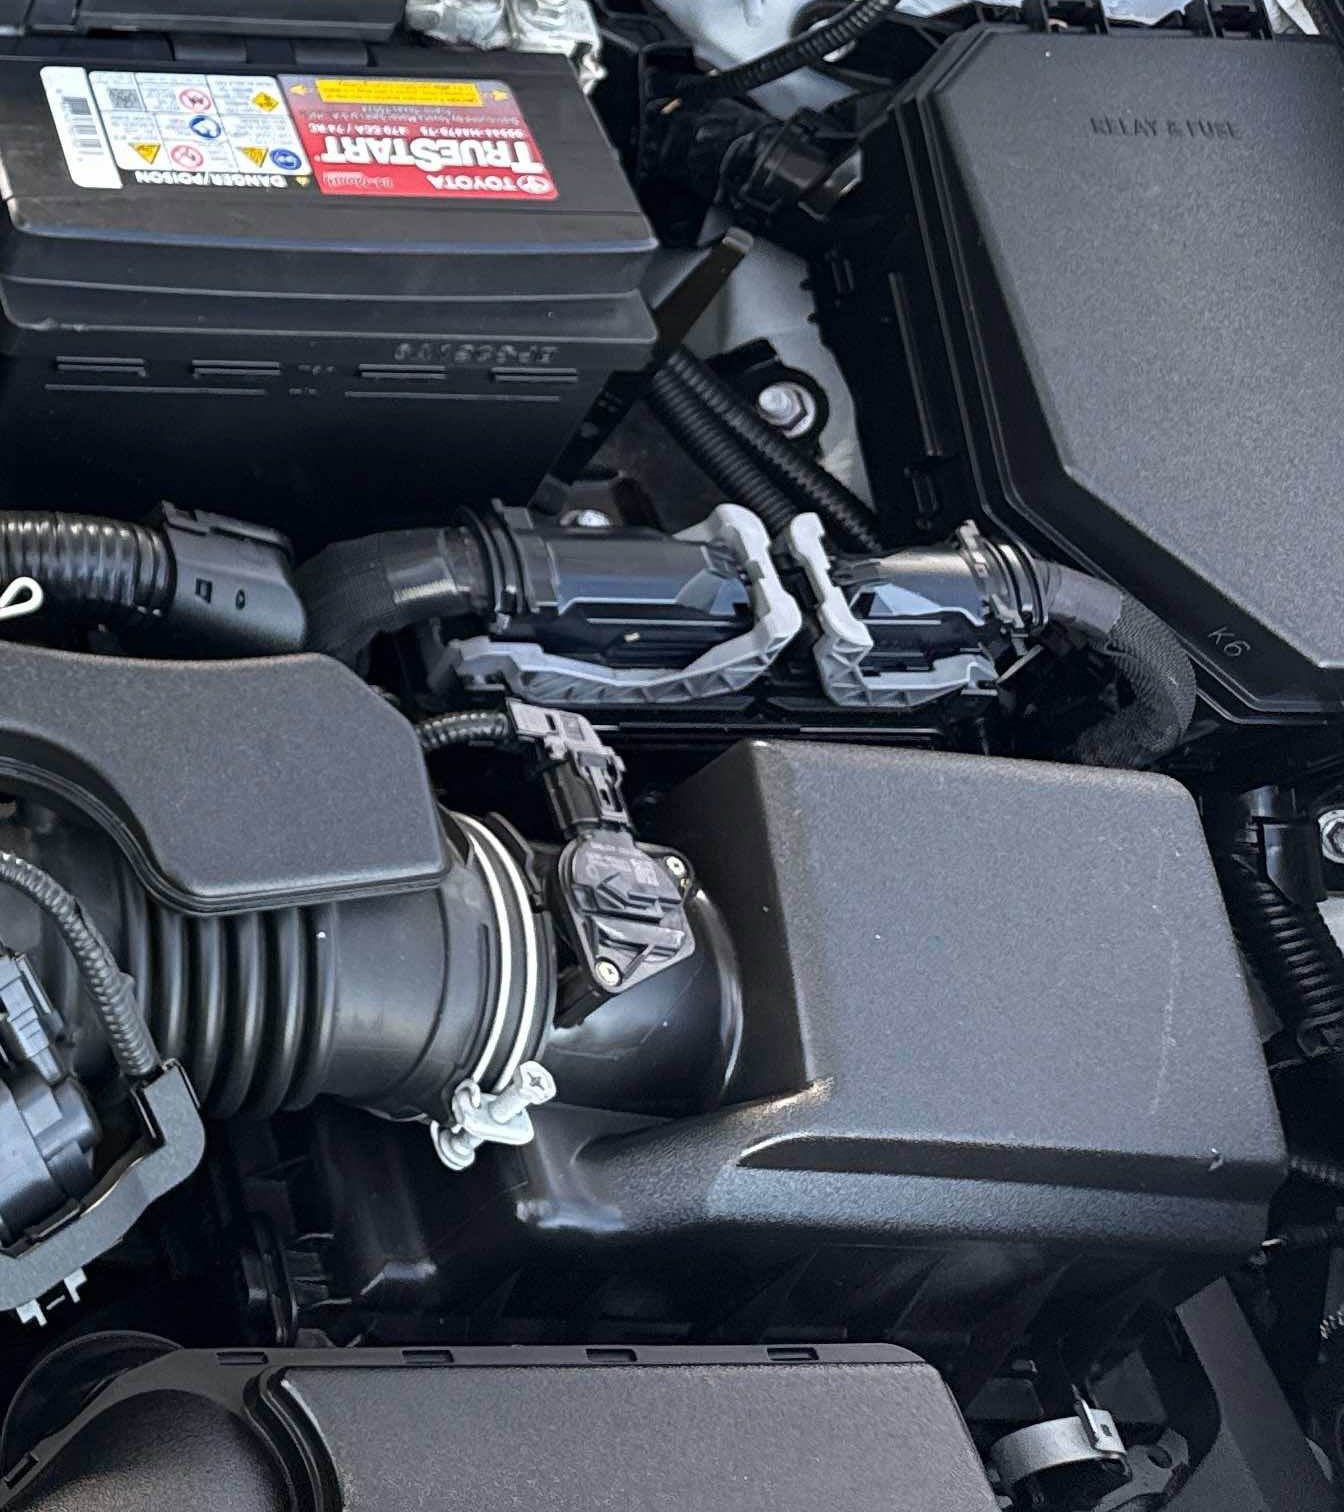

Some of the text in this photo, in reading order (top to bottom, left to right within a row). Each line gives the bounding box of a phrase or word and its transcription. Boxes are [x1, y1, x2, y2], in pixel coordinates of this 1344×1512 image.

[1089, 115, 1158, 138] RELAY
[134, 169, 288, 189] DANGER/POISON
[425, 174, 518, 191] TOYOTA
